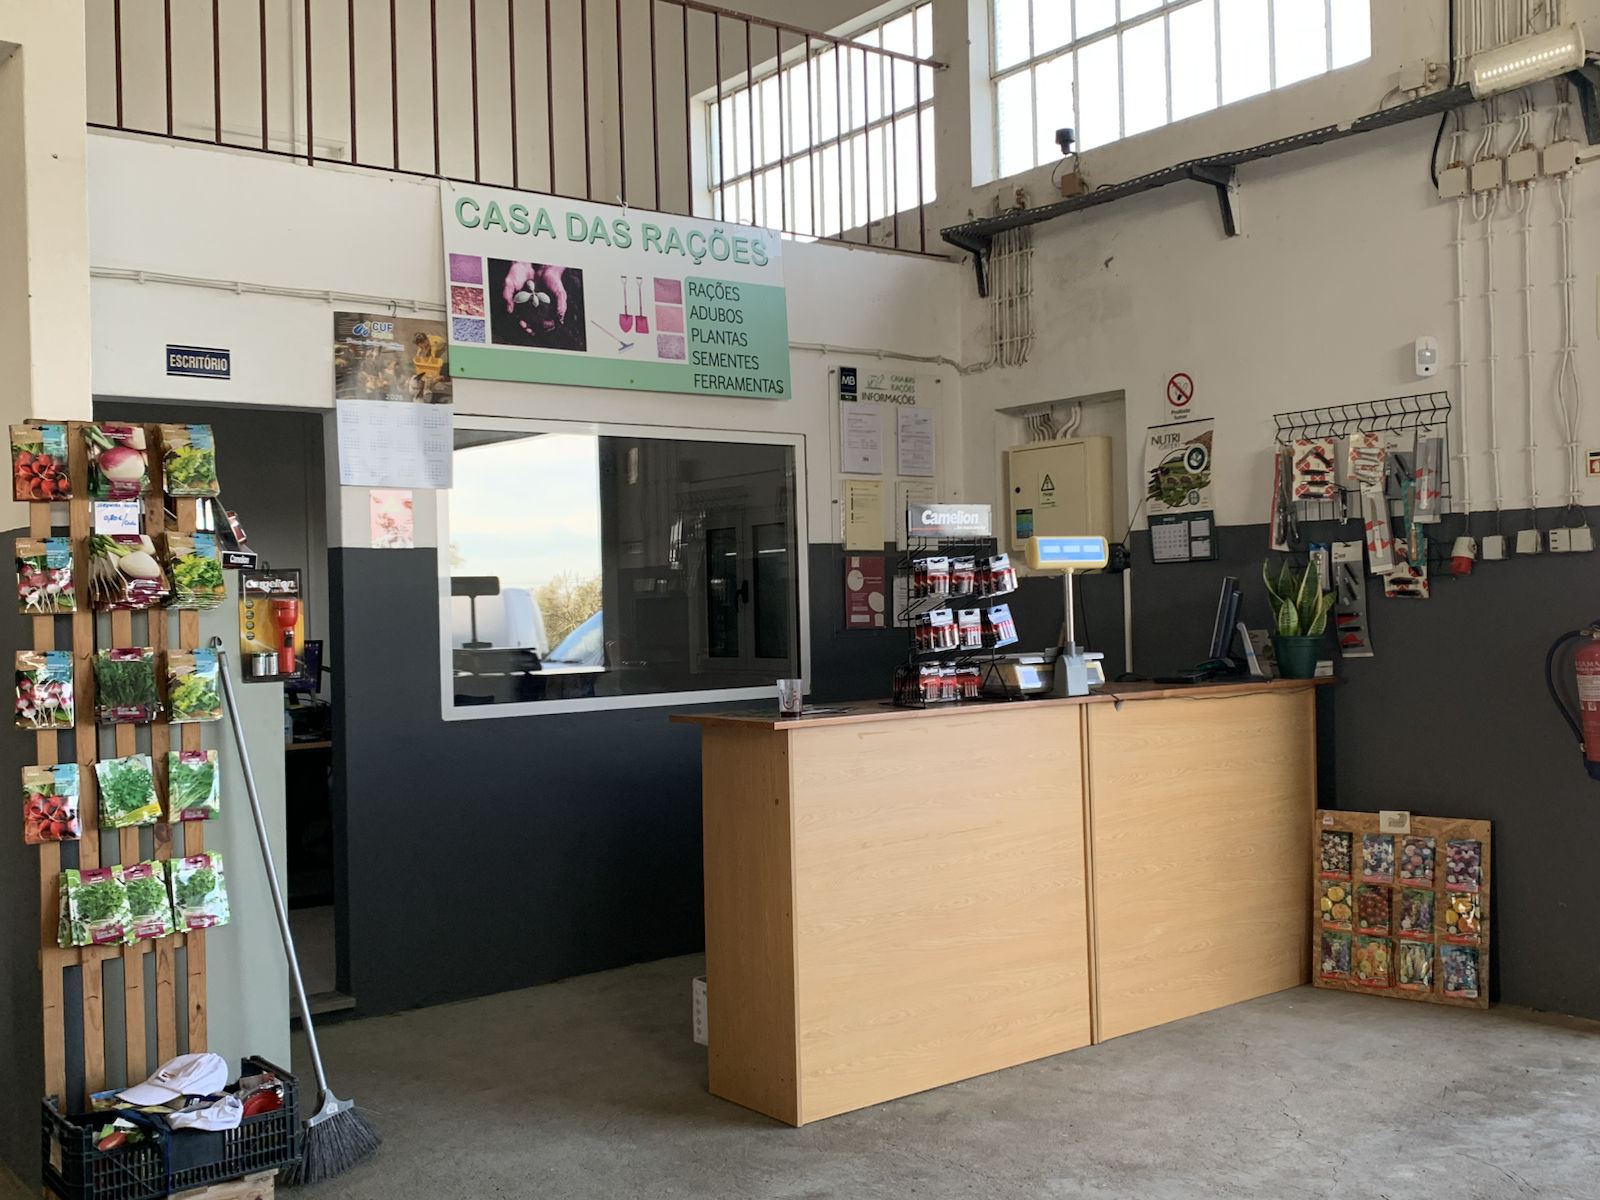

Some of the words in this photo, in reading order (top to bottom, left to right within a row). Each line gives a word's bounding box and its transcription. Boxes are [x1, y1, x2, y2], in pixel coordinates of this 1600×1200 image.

[455, 197, 556, 239] CASA
[566, 212, 632, 249] DAS
[641, 223, 769, 267] RAÇÕES
[688, 282, 740, 302] RAÇÕES
[690, 305, 744, 325] ADUBOS
[372, 322, 393, 332] CUF
[691, 327, 748, 347] PLANTAS
[169, 354, 228, 371] ESCRITÓRIO
[692, 350, 759, 370] SEMENTES
[694, 373, 784, 394] FERRAMENTAS
[841, 375, 855, 386] MB
[861, 392, 916, 405] INFORMAÇÕES
[1151, 433, 1180, 445] NUTRI
[921, 509, 979, 525] Camelion
